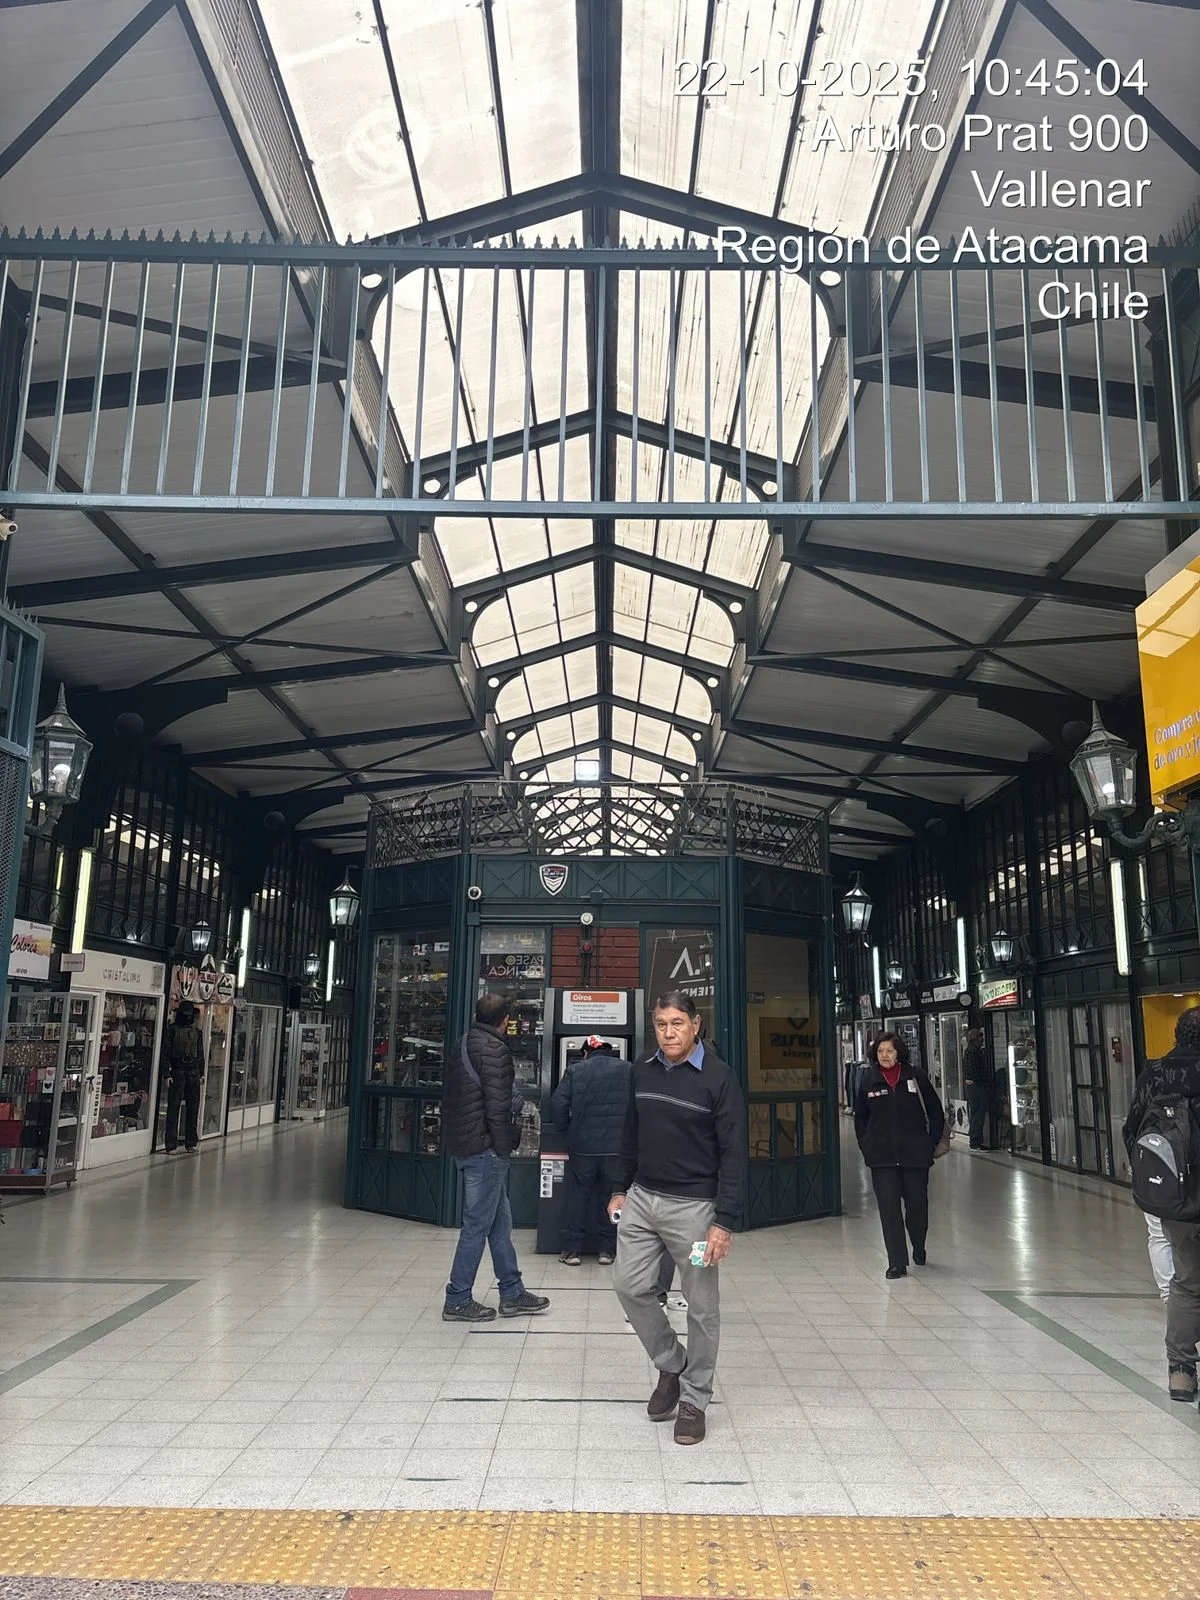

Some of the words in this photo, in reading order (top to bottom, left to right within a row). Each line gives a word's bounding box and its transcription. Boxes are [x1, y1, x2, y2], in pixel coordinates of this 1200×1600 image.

[1154, 713, 1193, 745] Compra
[1154, 752, 1166, 770] de
[9, 933, 37, 953] Colores
[572, 993, 592, 1001] Giros
